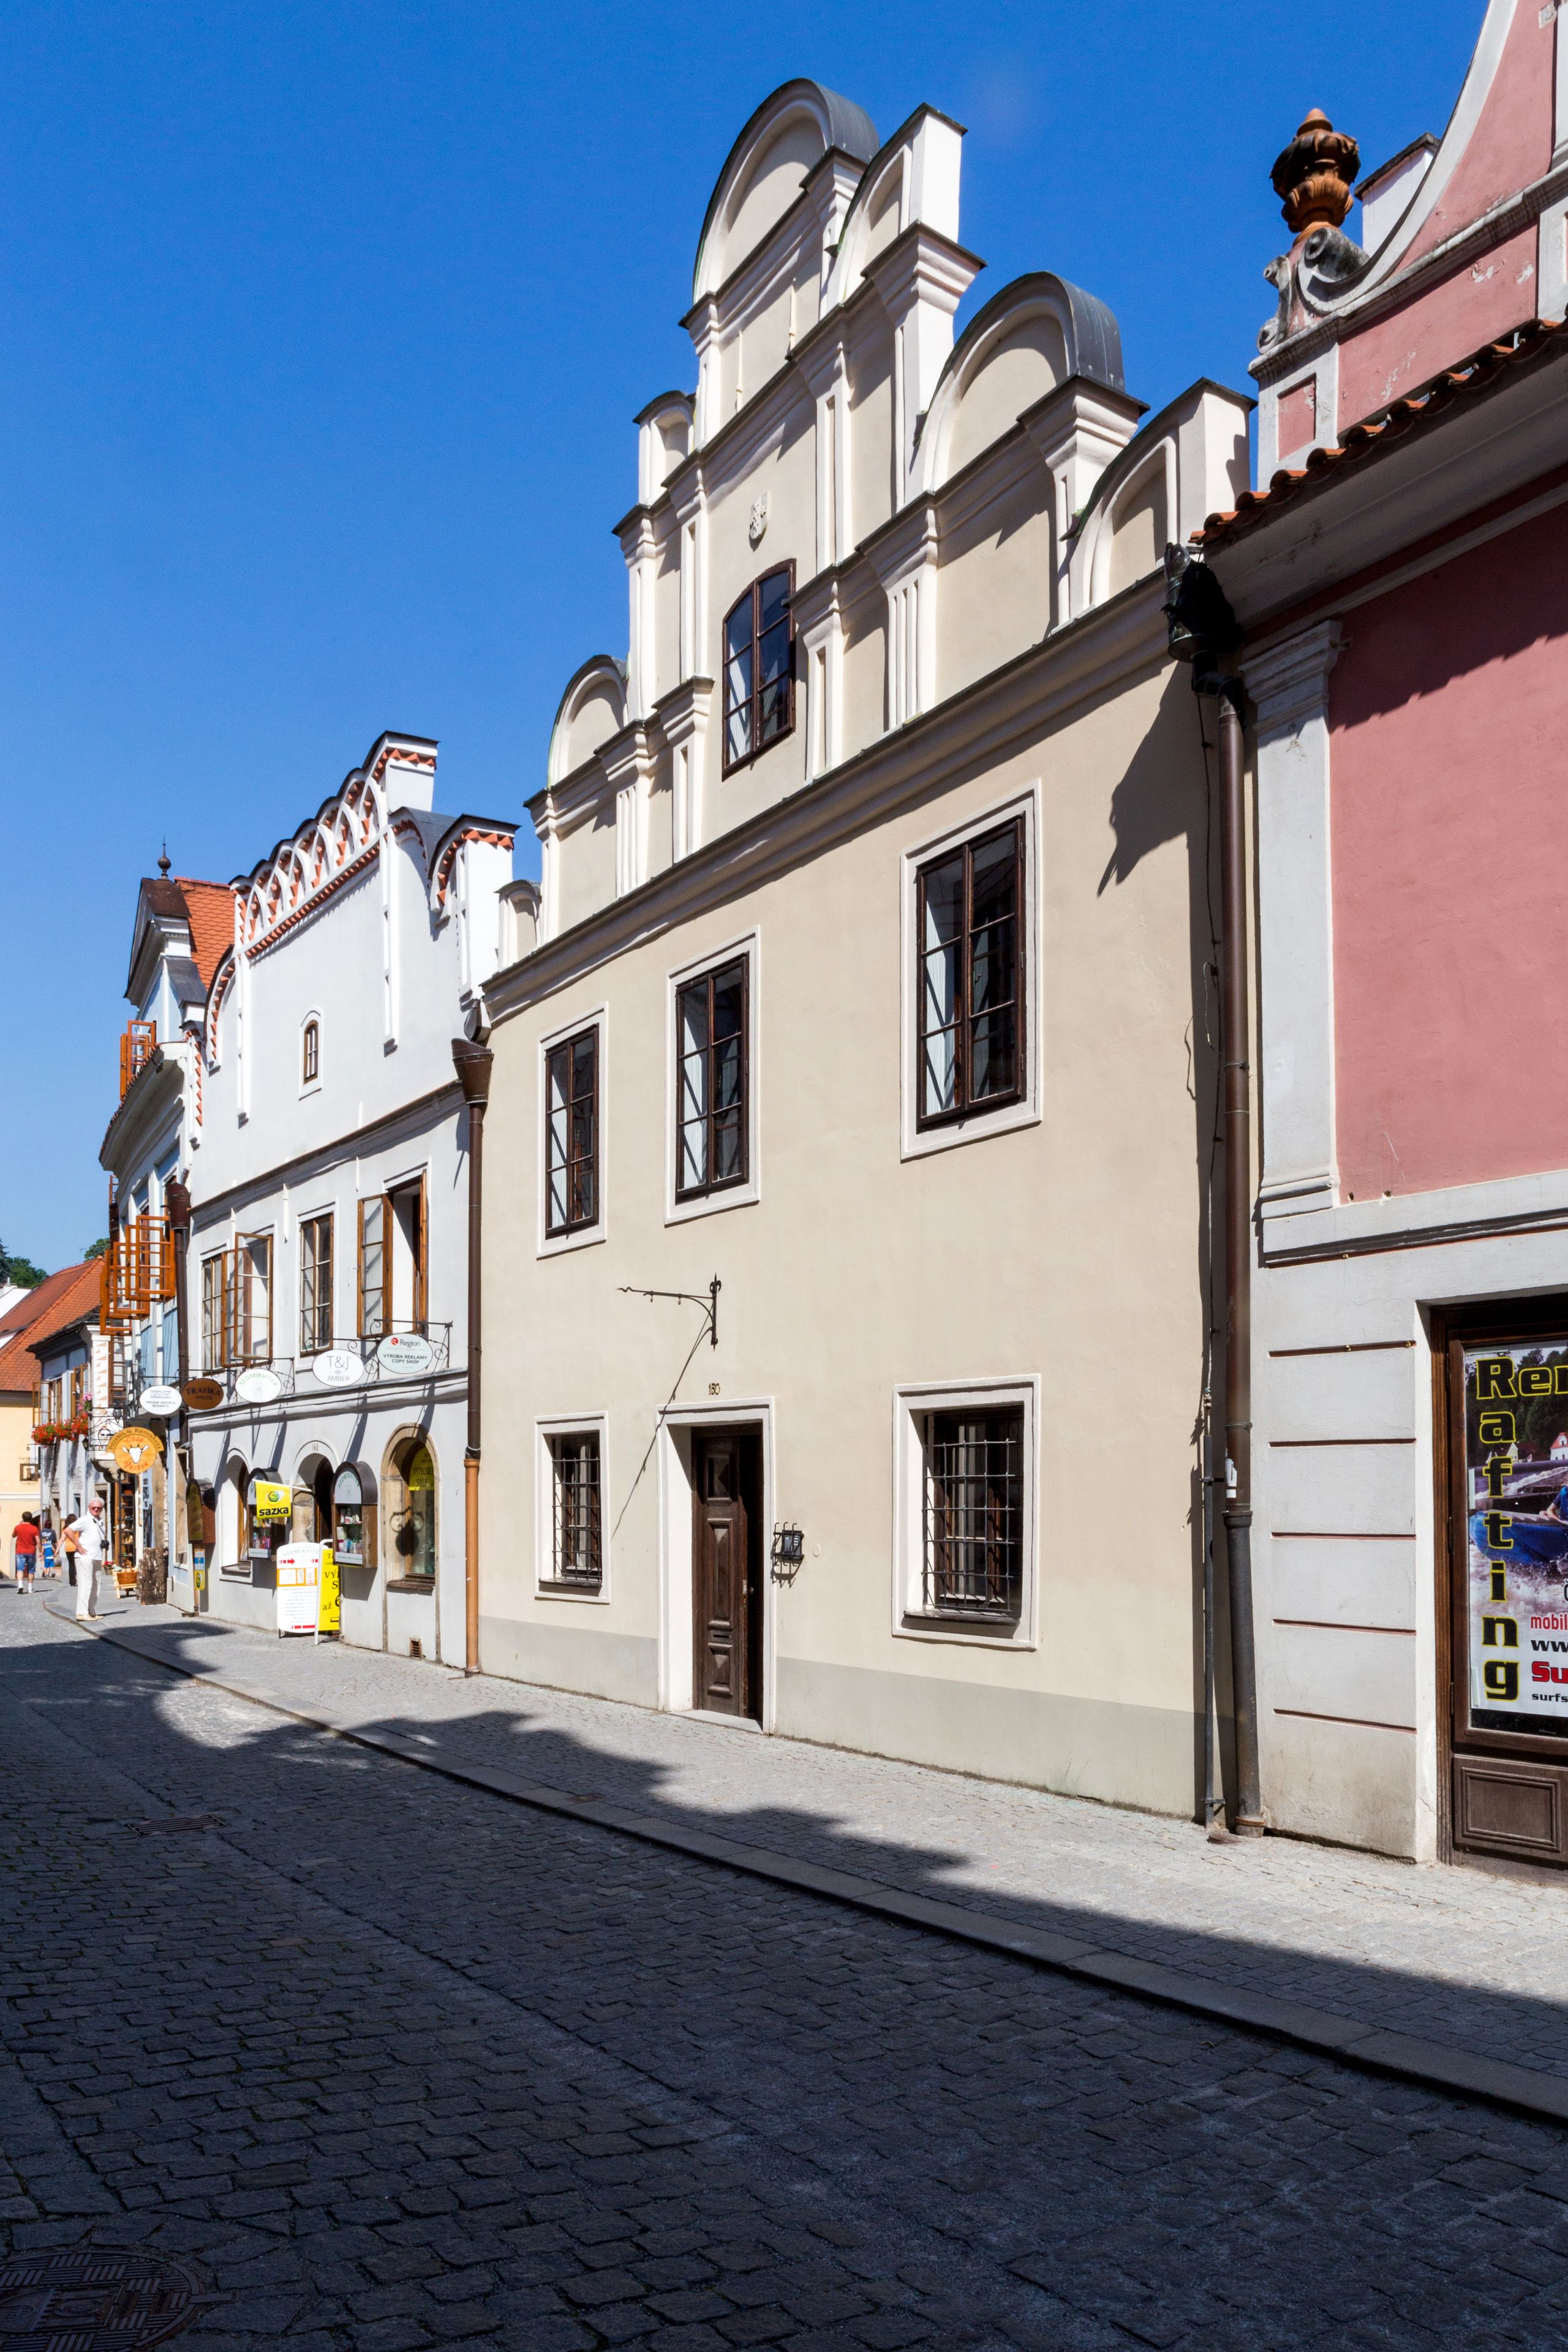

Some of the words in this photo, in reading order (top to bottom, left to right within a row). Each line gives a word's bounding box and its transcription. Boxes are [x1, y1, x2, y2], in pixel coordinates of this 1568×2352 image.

[399, 1339, 421, 1348] Region
[186, 1387, 221, 1397] TRAFIKA
[708, 1382, 721, 1395] 150
